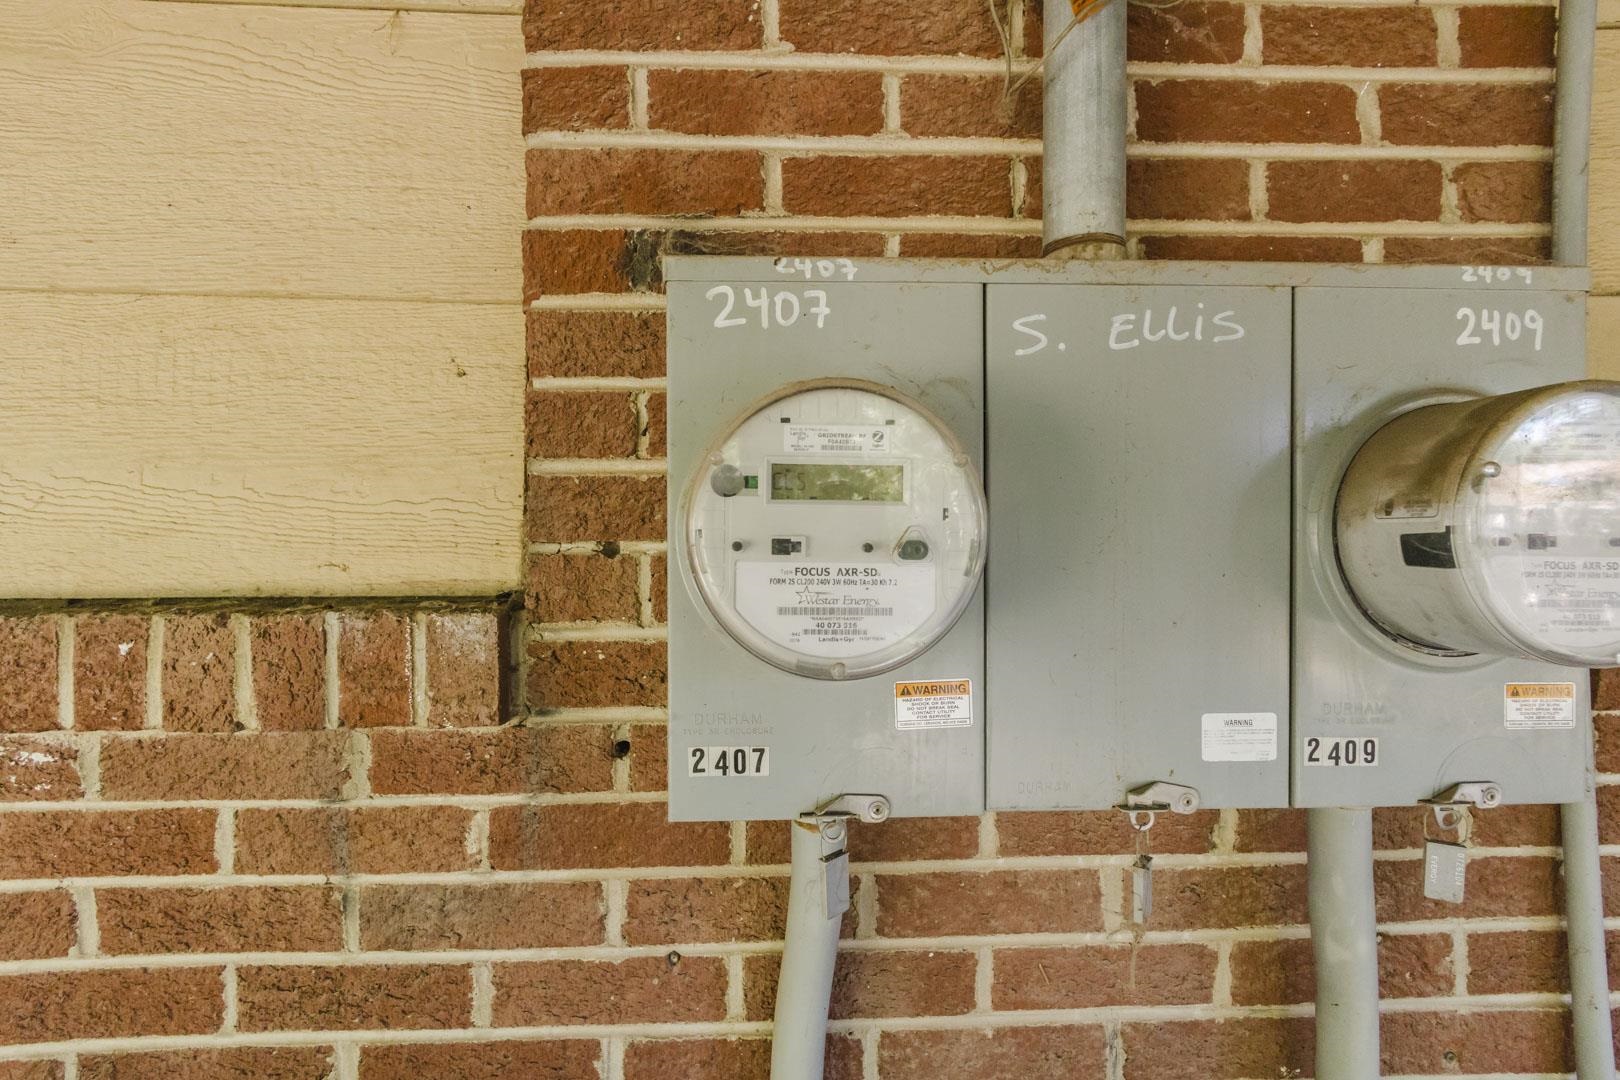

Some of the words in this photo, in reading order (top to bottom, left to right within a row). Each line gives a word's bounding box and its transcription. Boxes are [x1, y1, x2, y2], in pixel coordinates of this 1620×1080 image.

[775, 257, 858, 281] 2407
[1461, 266, 1533, 284] 2409
[705, 285, 831, 330] 2407
[1012, 313, 1066, 356] S.
[1456, 307, 1543, 351] 2409
[794, 567, 831, 577] FOCUS
[836, 567, 878, 577] AXR-SD
[1543, 561, 1577, 570] FOCUS
[796, 578, 815, 586] CL200
[816, 578, 831, 586] 240V
[832, 578, 842, 586] 3W
[843, 578, 857, 586] 60Hz
[843, 595, 878, 608] Energy
[912, 684, 967, 695] WARNING
[1521, 687, 1571, 697] WARNING
[1307, 737, 1376, 766] 2409
[691, 747, 766, 776] 2407
